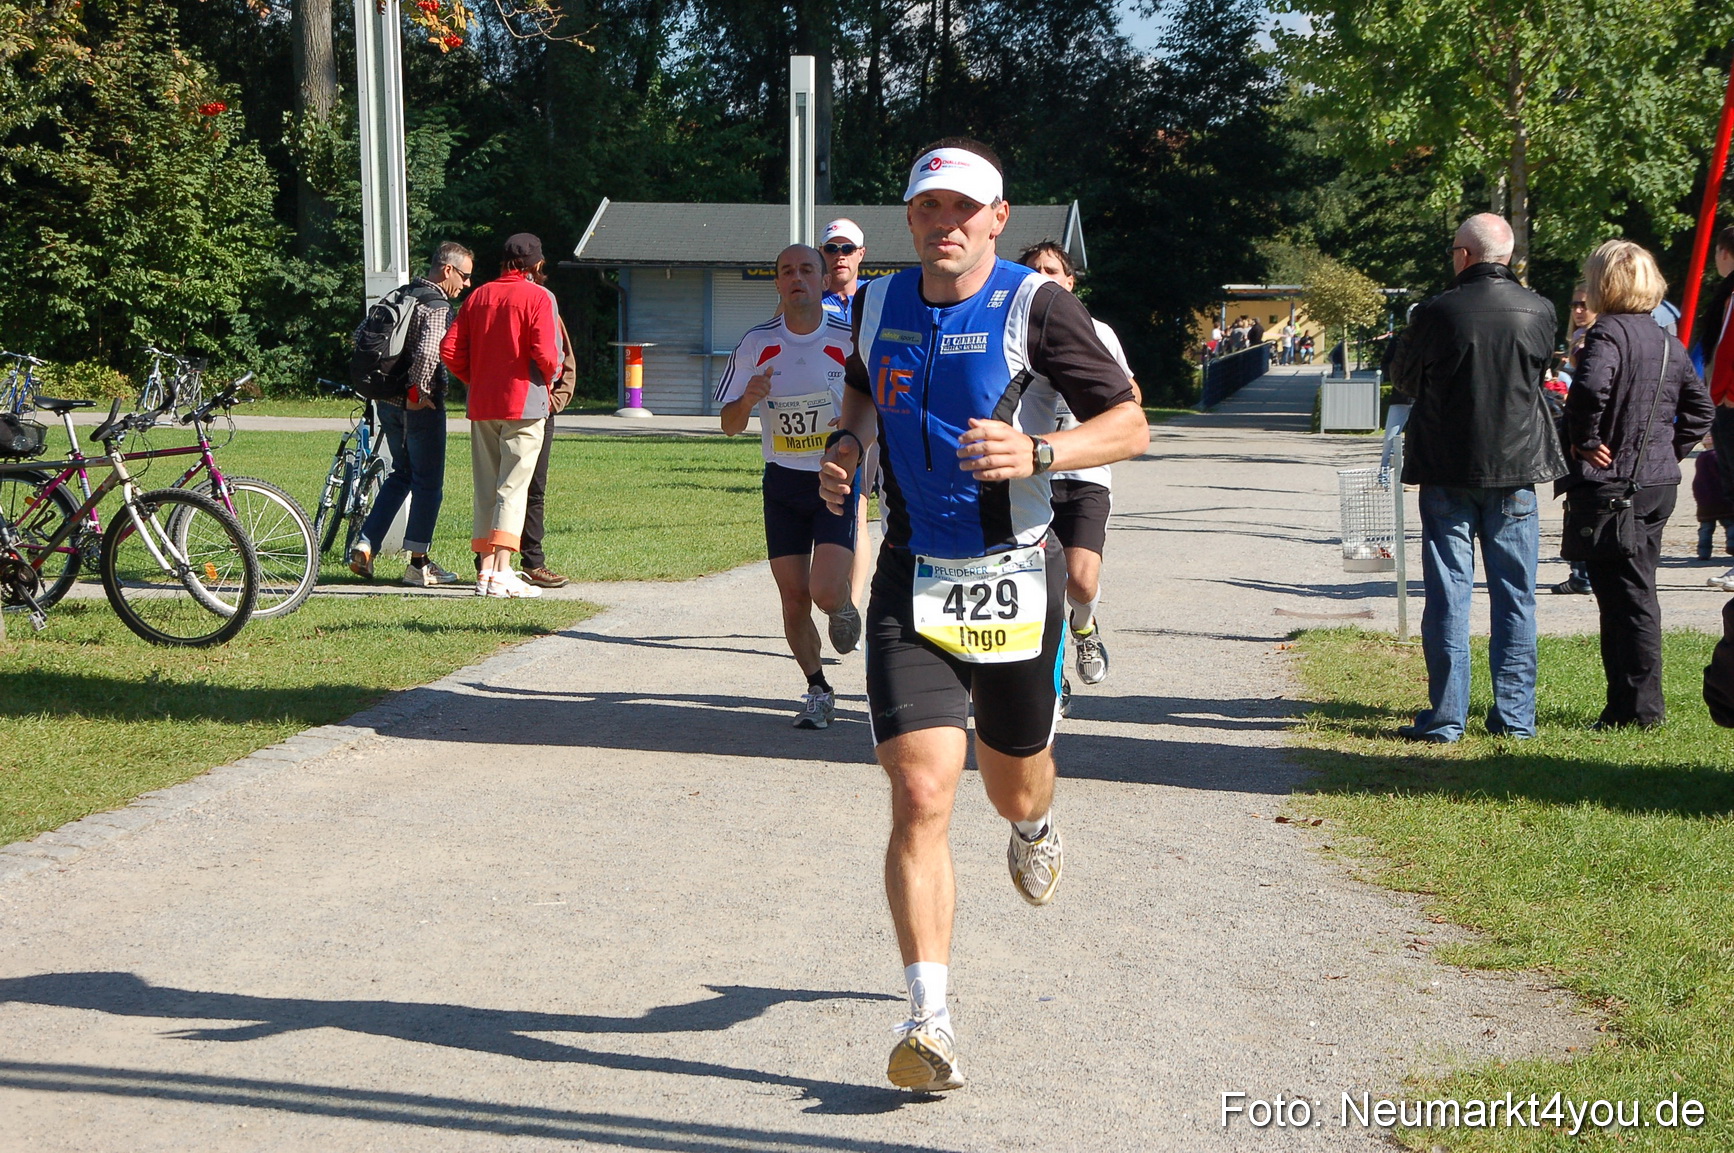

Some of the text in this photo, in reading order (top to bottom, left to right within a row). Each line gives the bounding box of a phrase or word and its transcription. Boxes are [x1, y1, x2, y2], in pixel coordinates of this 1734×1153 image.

[986, 301, 1003, 310] cep
[779, 410, 819, 435] 337
[785, 435, 823, 449] Martin
[934, 565, 988, 577] PFLEIDERER
[942, 578, 1019, 621] 429
[959, 626, 1007, 652] Ingo
